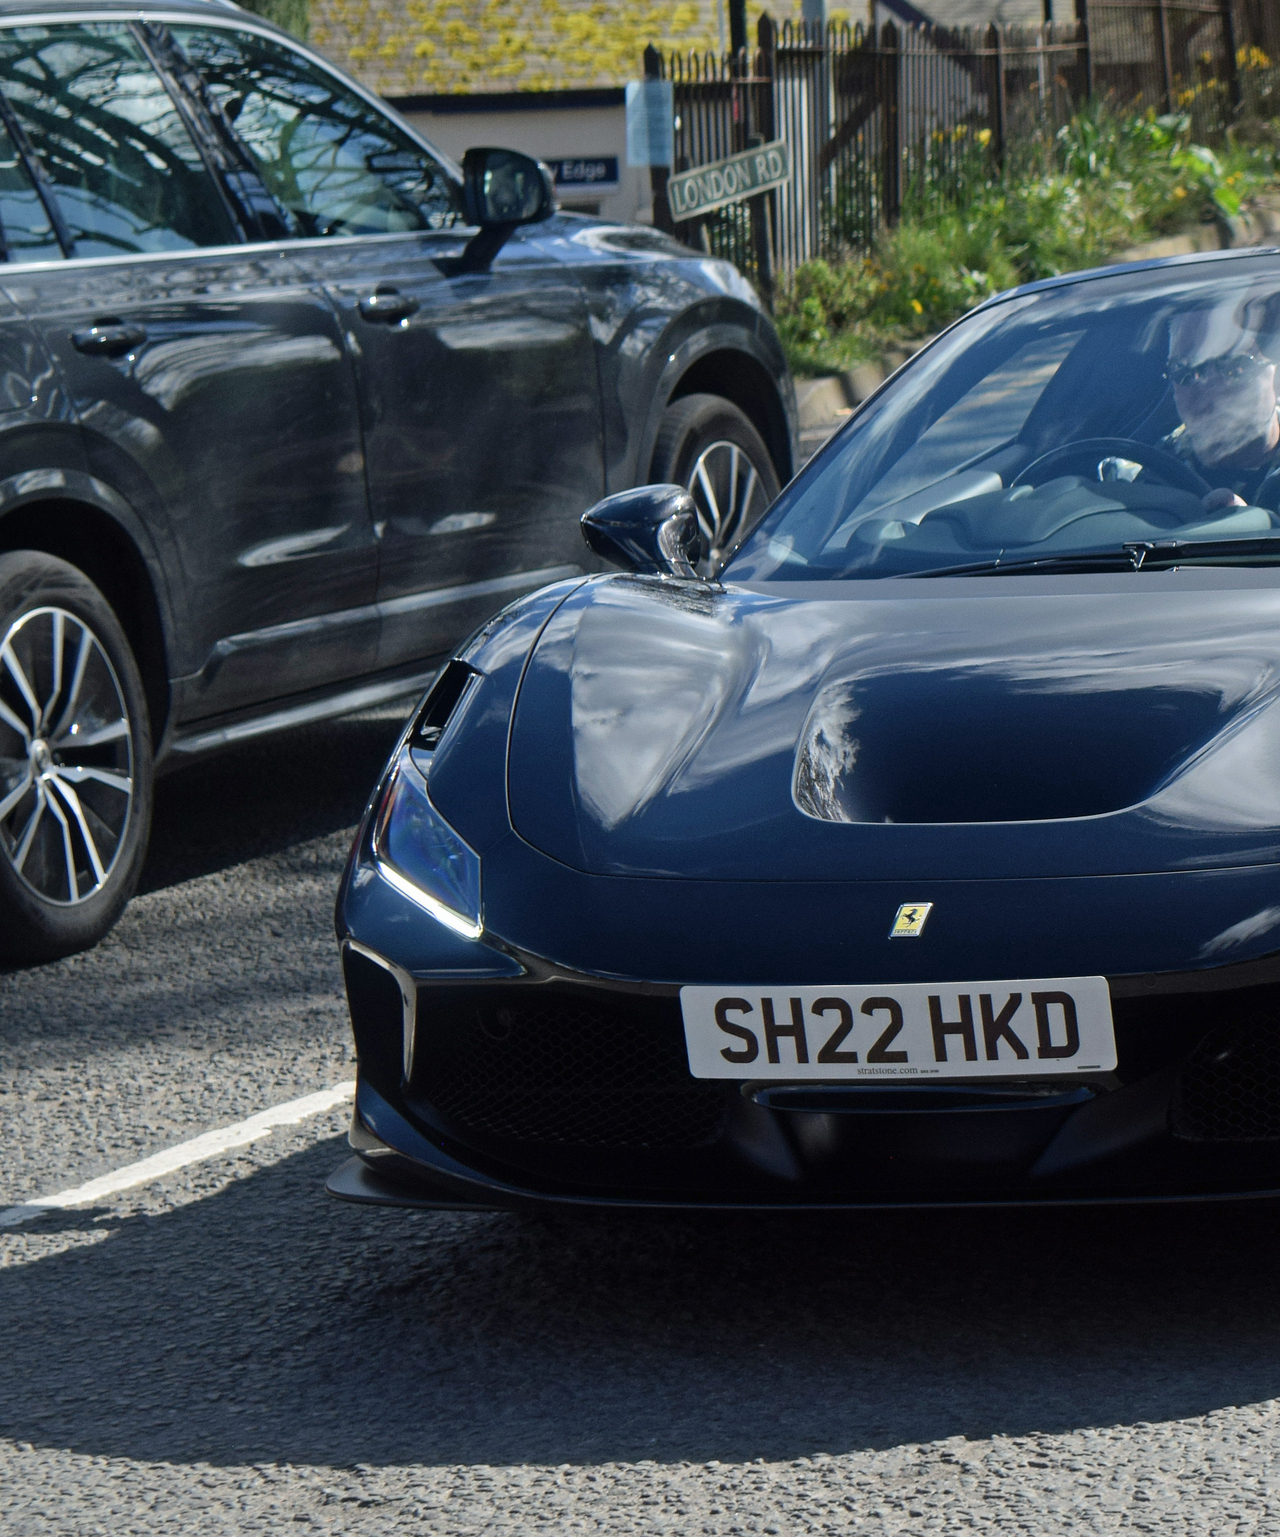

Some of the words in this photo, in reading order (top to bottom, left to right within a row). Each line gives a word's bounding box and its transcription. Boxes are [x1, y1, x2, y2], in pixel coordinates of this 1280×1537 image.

[562, 160, 607, 181] Edge
[673, 162, 751, 212] LONDON
[714, 996, 909, 1064] SH22
[927, 990, 1081, 1062] HKD
[857, 1067, 918, 1075] stratstone.com
